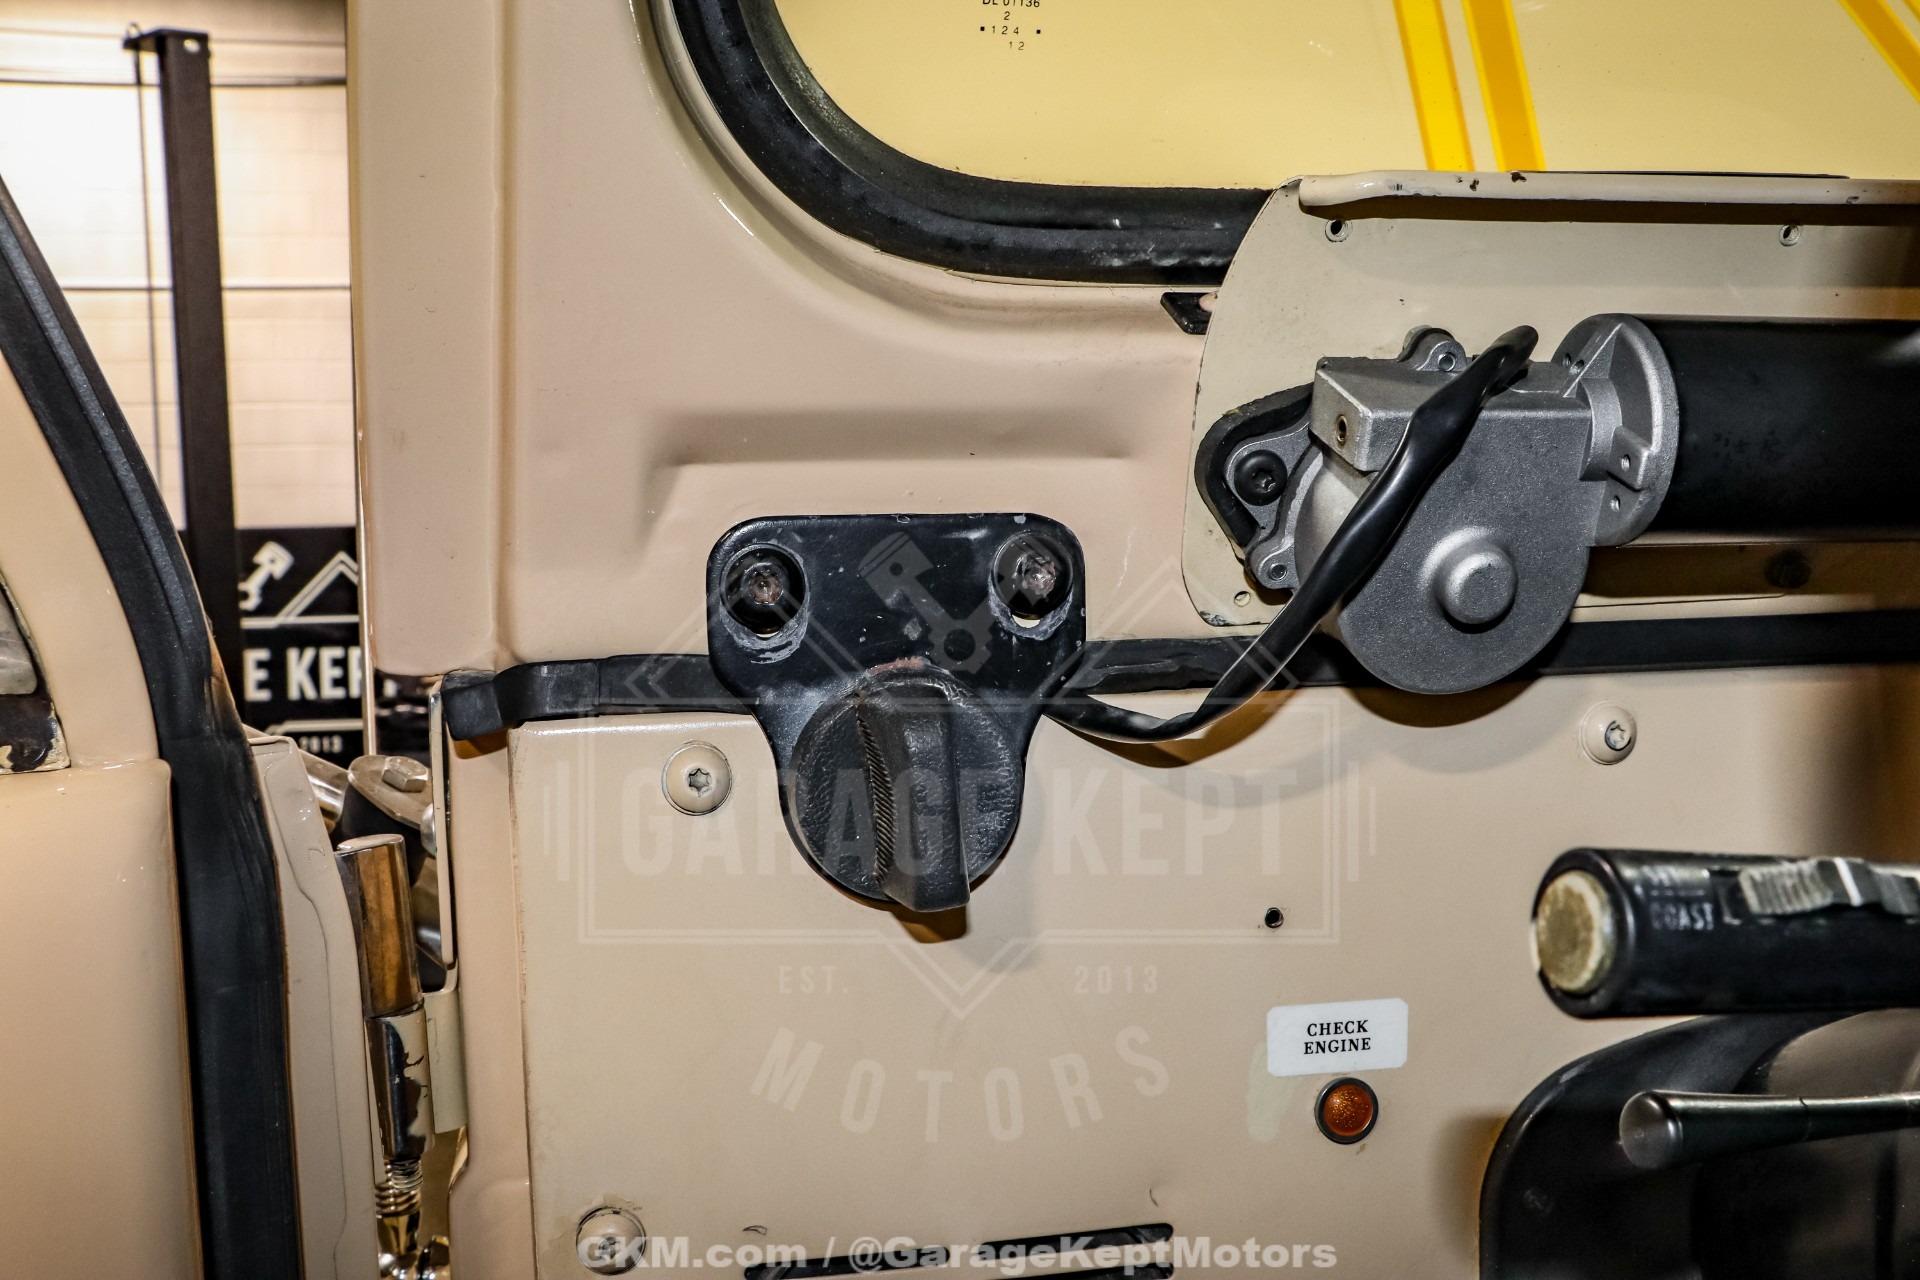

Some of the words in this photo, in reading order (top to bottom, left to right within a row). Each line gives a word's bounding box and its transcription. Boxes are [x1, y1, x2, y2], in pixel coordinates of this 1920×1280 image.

[1003, 10, 1010, 20] 2
[1307, 1020, 1369, 1037] CHECK
[1304, 1037, 1371, 1055] ENGINE
